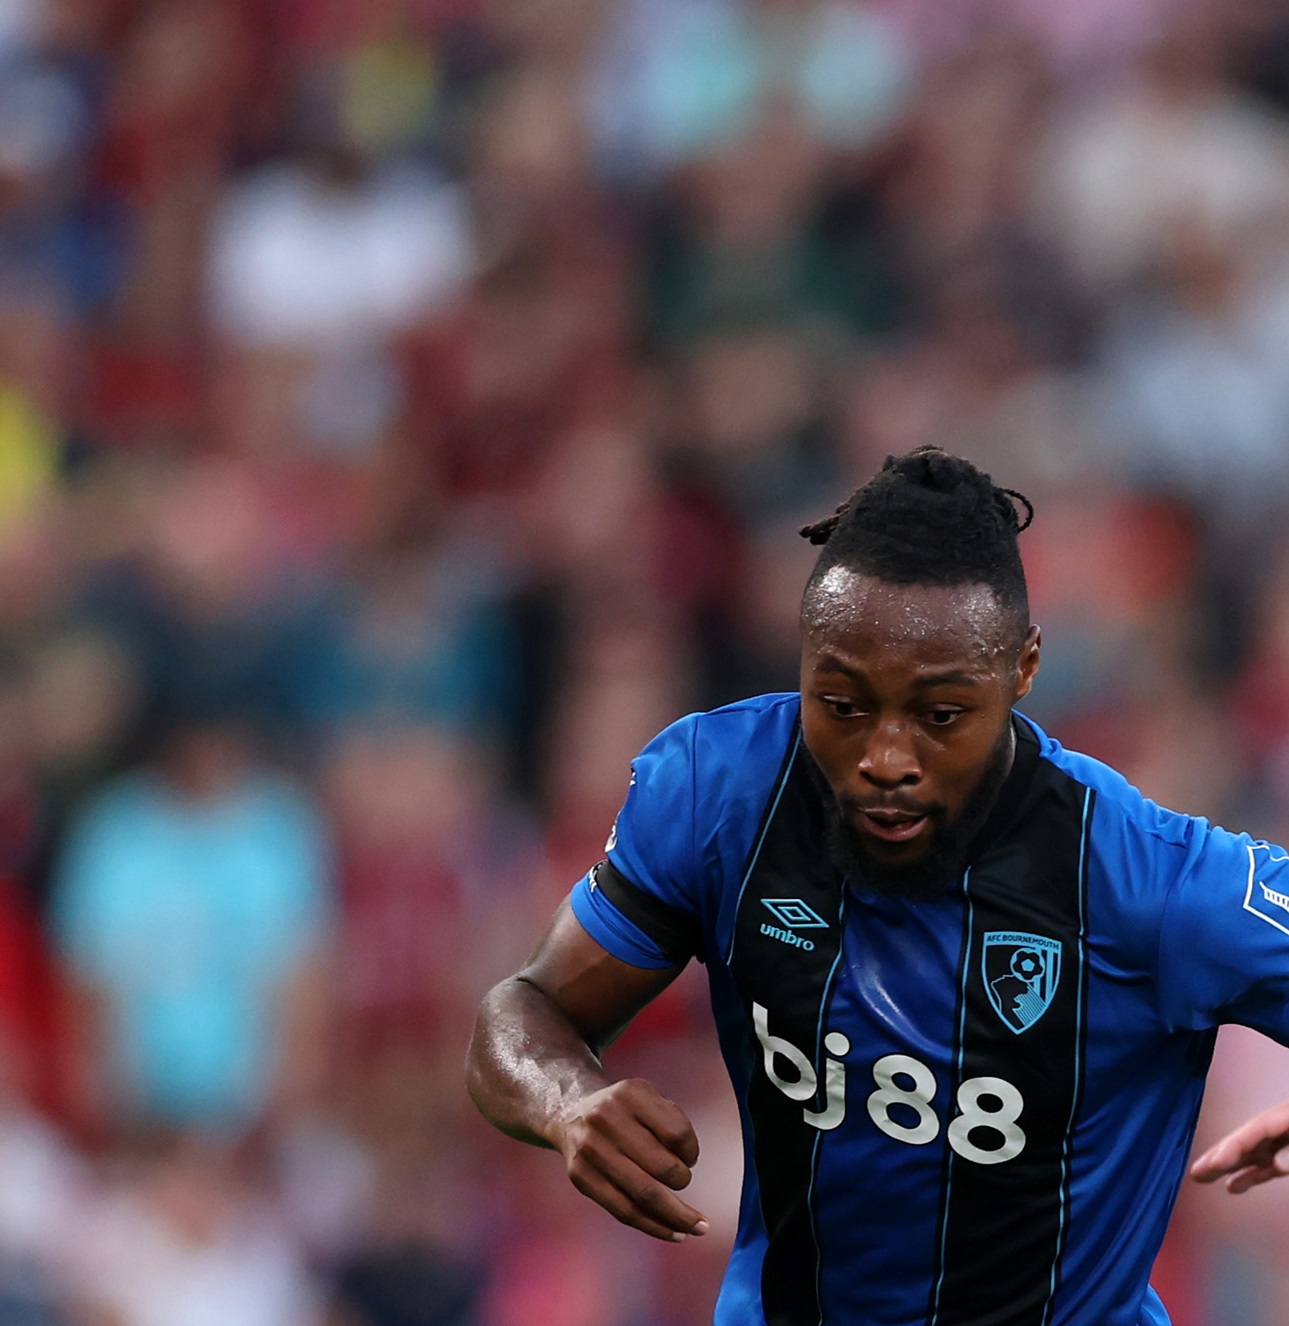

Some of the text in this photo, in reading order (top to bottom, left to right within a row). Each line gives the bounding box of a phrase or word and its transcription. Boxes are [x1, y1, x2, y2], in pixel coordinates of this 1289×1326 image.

[760, 923, 815, 951] umbro
[986, 934, 1060, 951] AFC BOURNEMOUTH
[752, 1000, 1027, 1165] bj88
